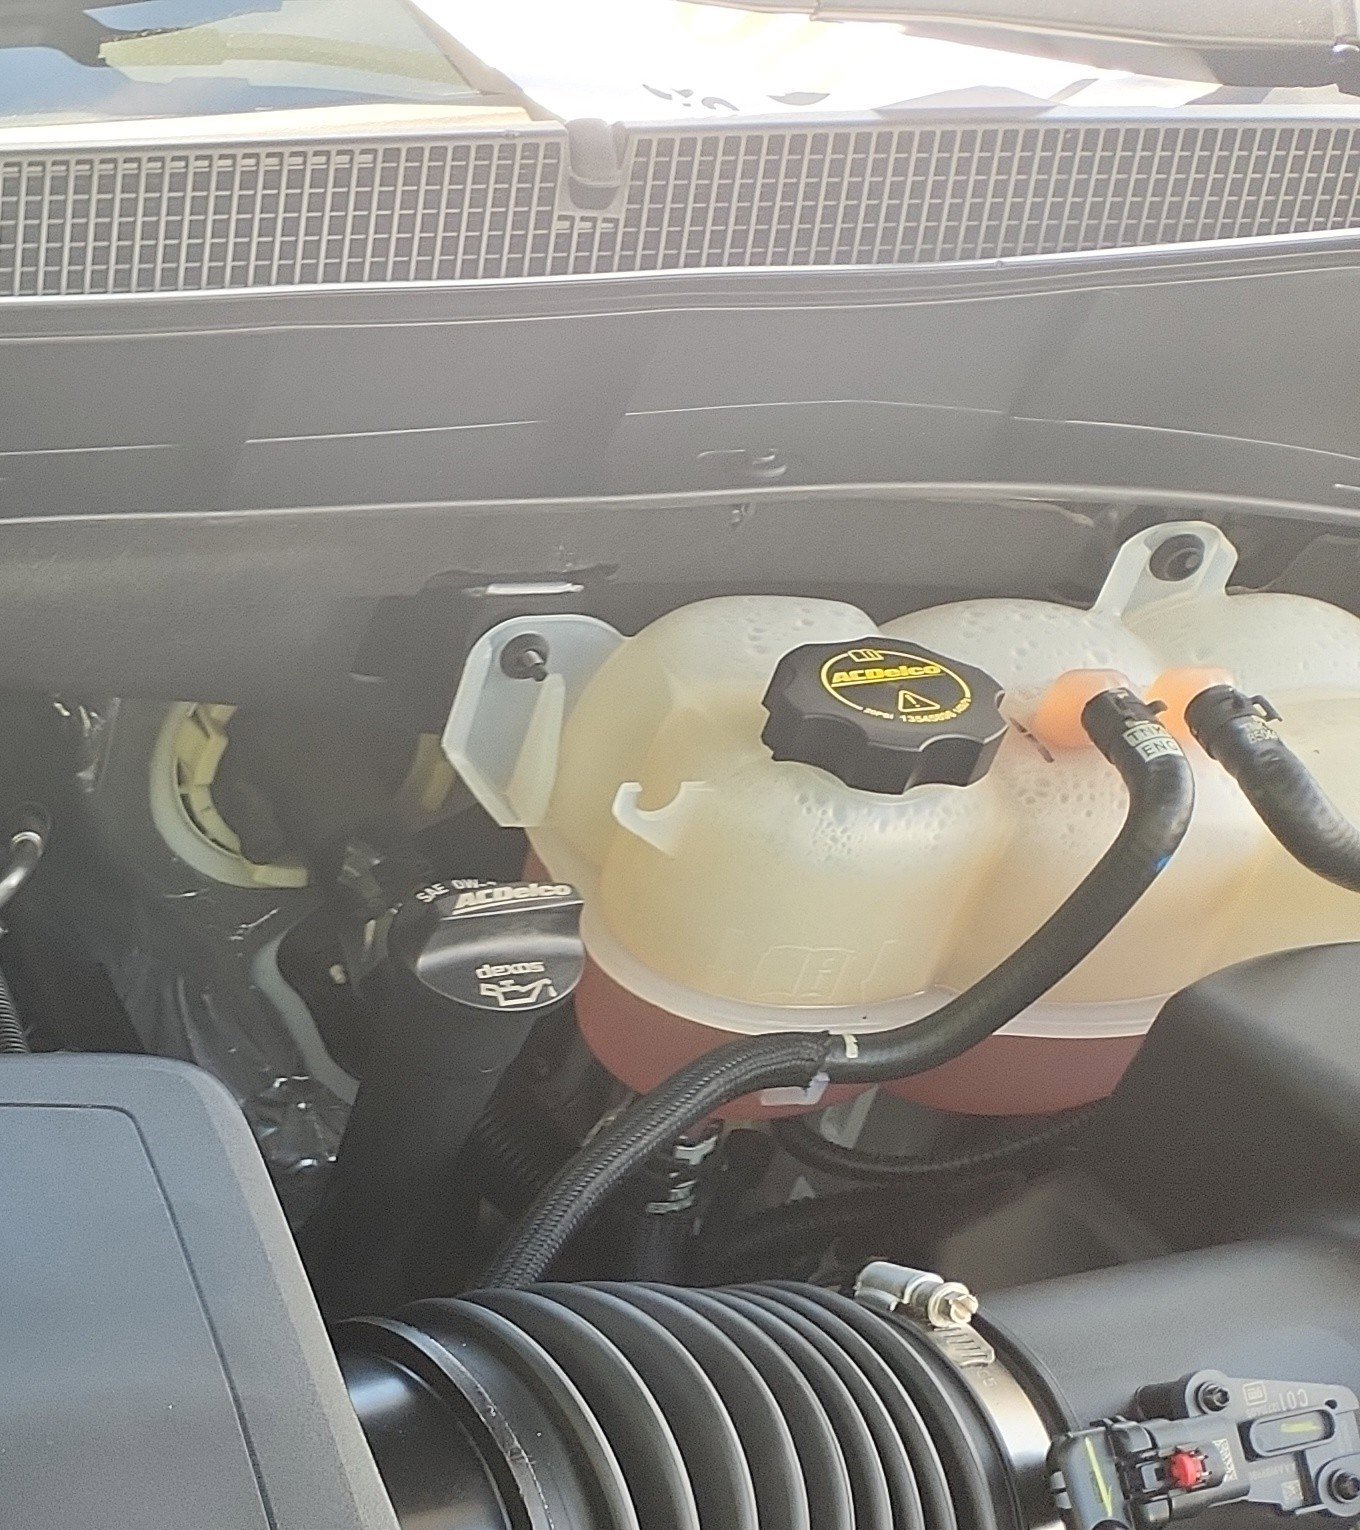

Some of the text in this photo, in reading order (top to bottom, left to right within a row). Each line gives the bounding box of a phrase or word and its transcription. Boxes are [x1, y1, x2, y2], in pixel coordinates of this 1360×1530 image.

[832, 665, 941, 684] ACDelco
[415, 882, 450, 903] SAE
[454, 883, 573, 909] ACDelco
[475, 961, 545, 979] dexos
